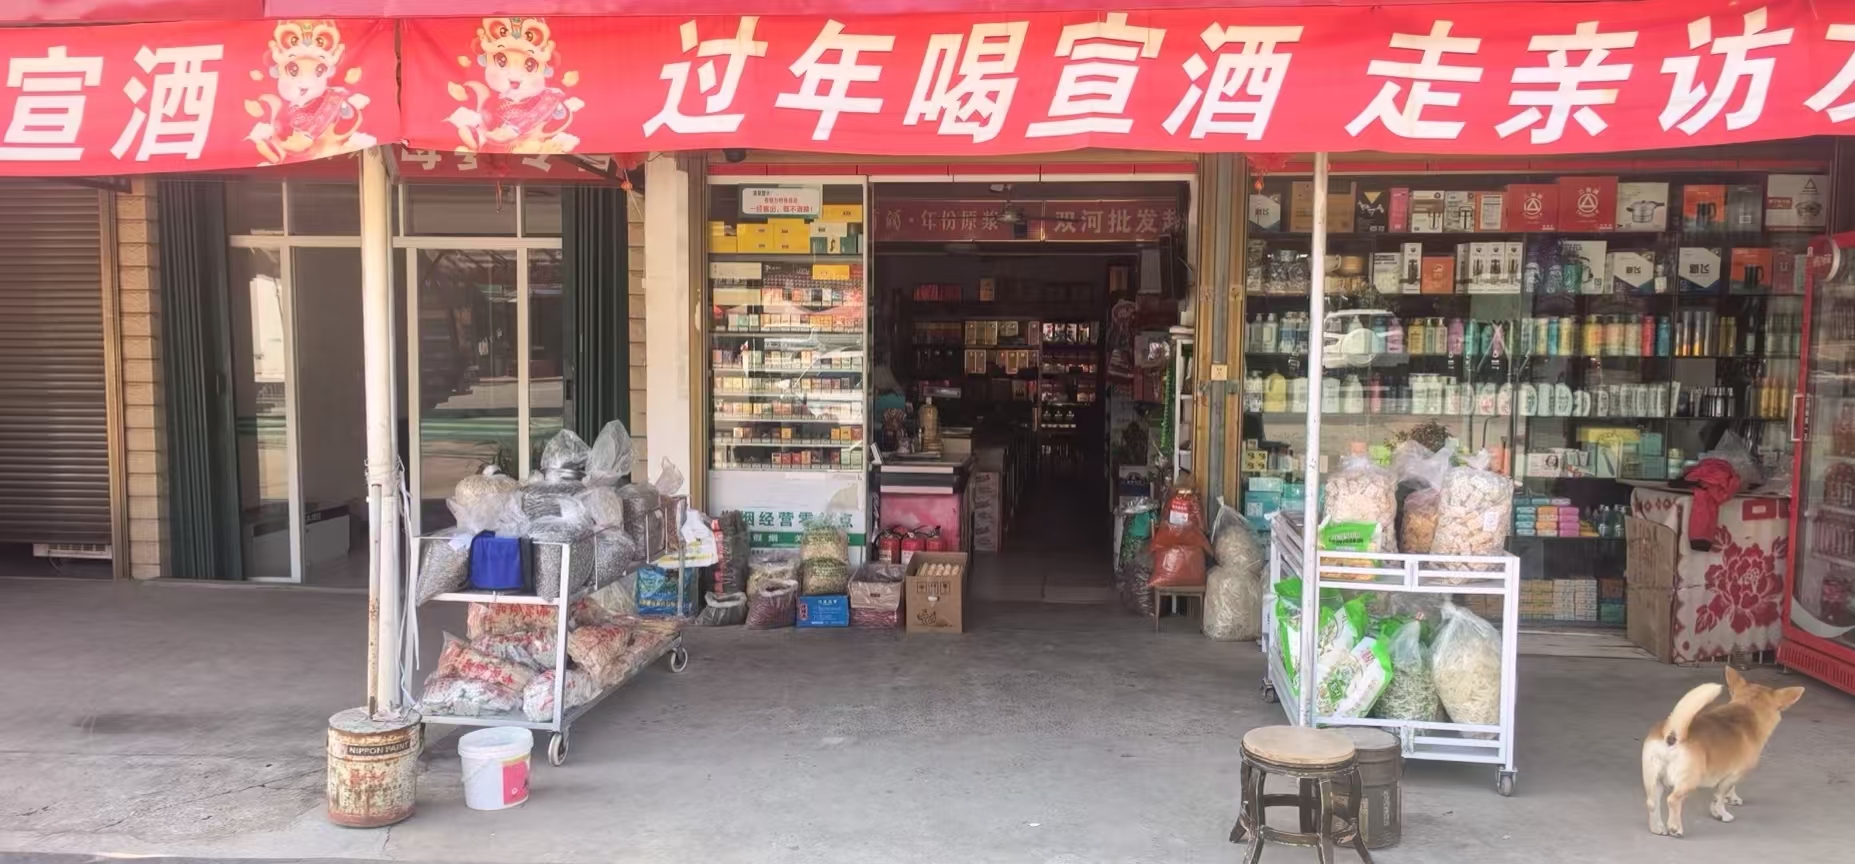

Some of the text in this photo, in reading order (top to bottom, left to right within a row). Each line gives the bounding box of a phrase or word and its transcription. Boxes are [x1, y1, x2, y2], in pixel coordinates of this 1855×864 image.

[0, 44, 224, 161] 宣酒
[643, 12, 1303, 144] 过年喝宣酒
[349, 742, 409, 755] NIPPON PAINT
